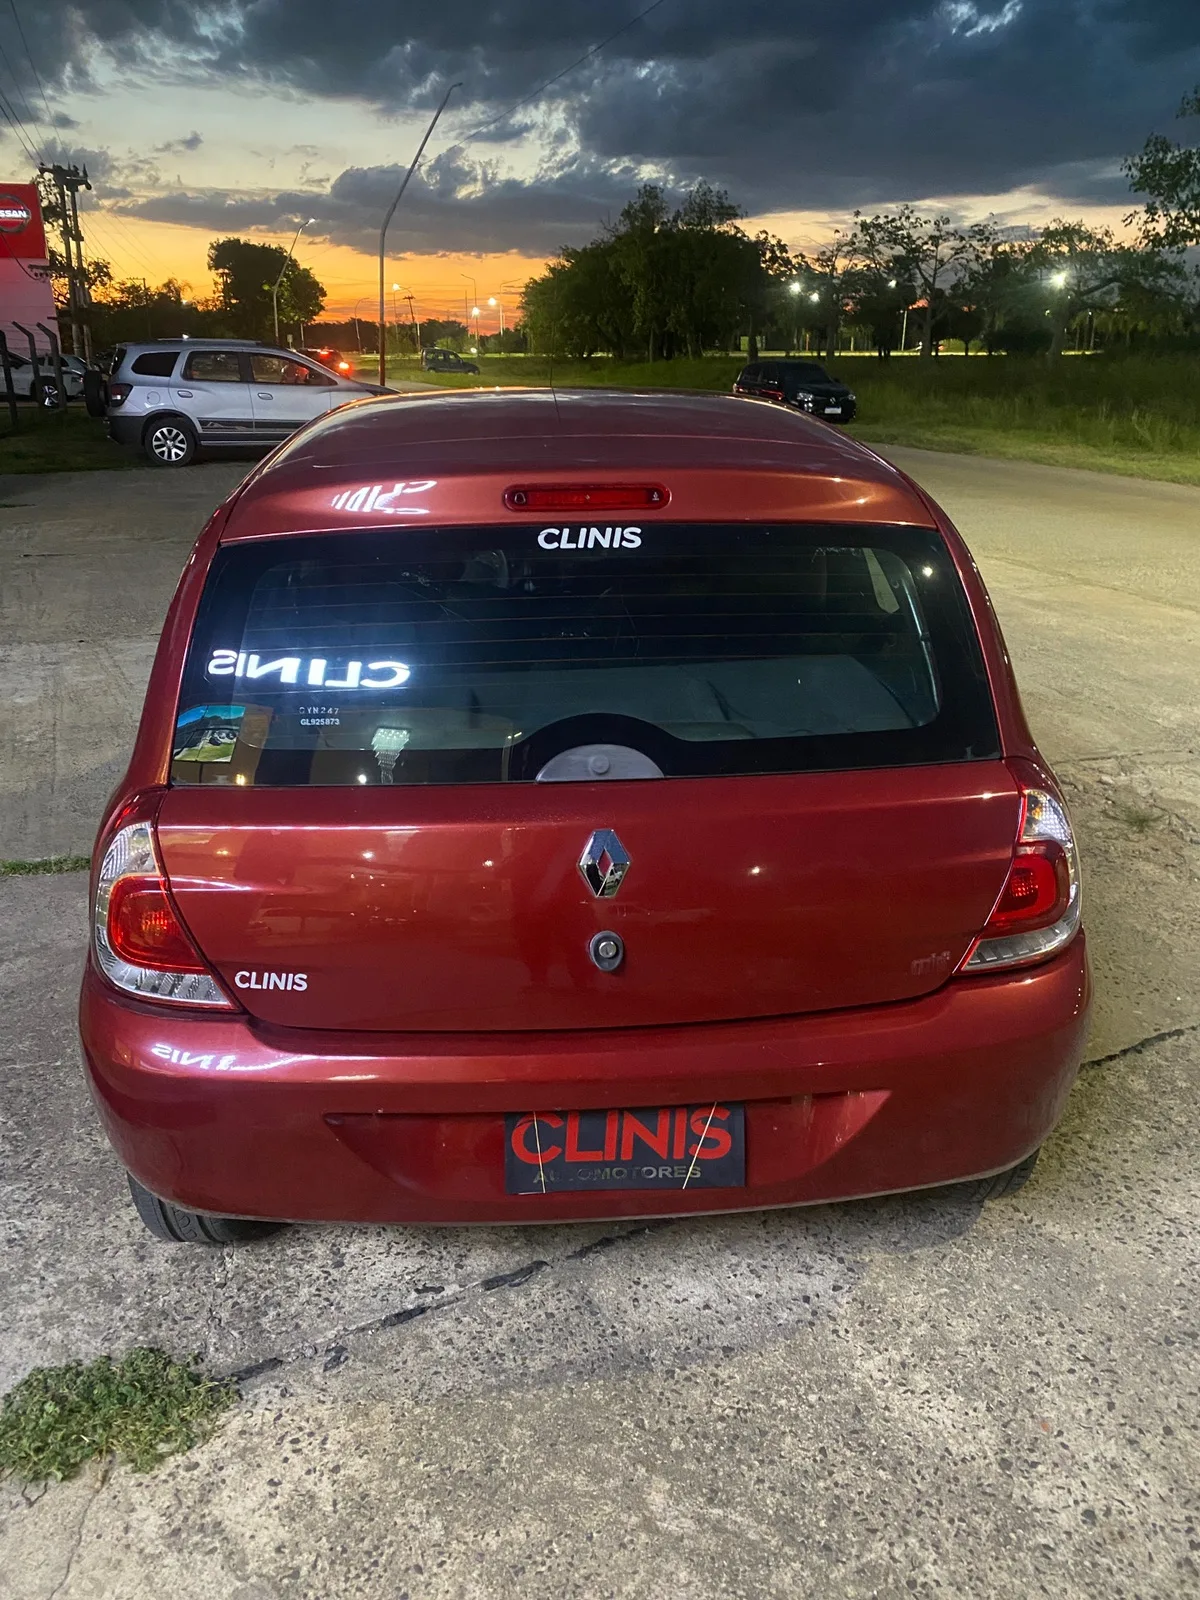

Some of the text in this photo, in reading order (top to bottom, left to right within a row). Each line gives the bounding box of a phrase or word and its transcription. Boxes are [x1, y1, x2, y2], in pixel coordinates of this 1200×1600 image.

[537, 526, 642, 550] CLINIS
[300, 718, 340, 726] GL925873
[234, 970, 308, 992] CLINIS
[511, 1106, 733, 1165] CLINIS
[533, 1165, 702, 1184] AUOMOTORES
